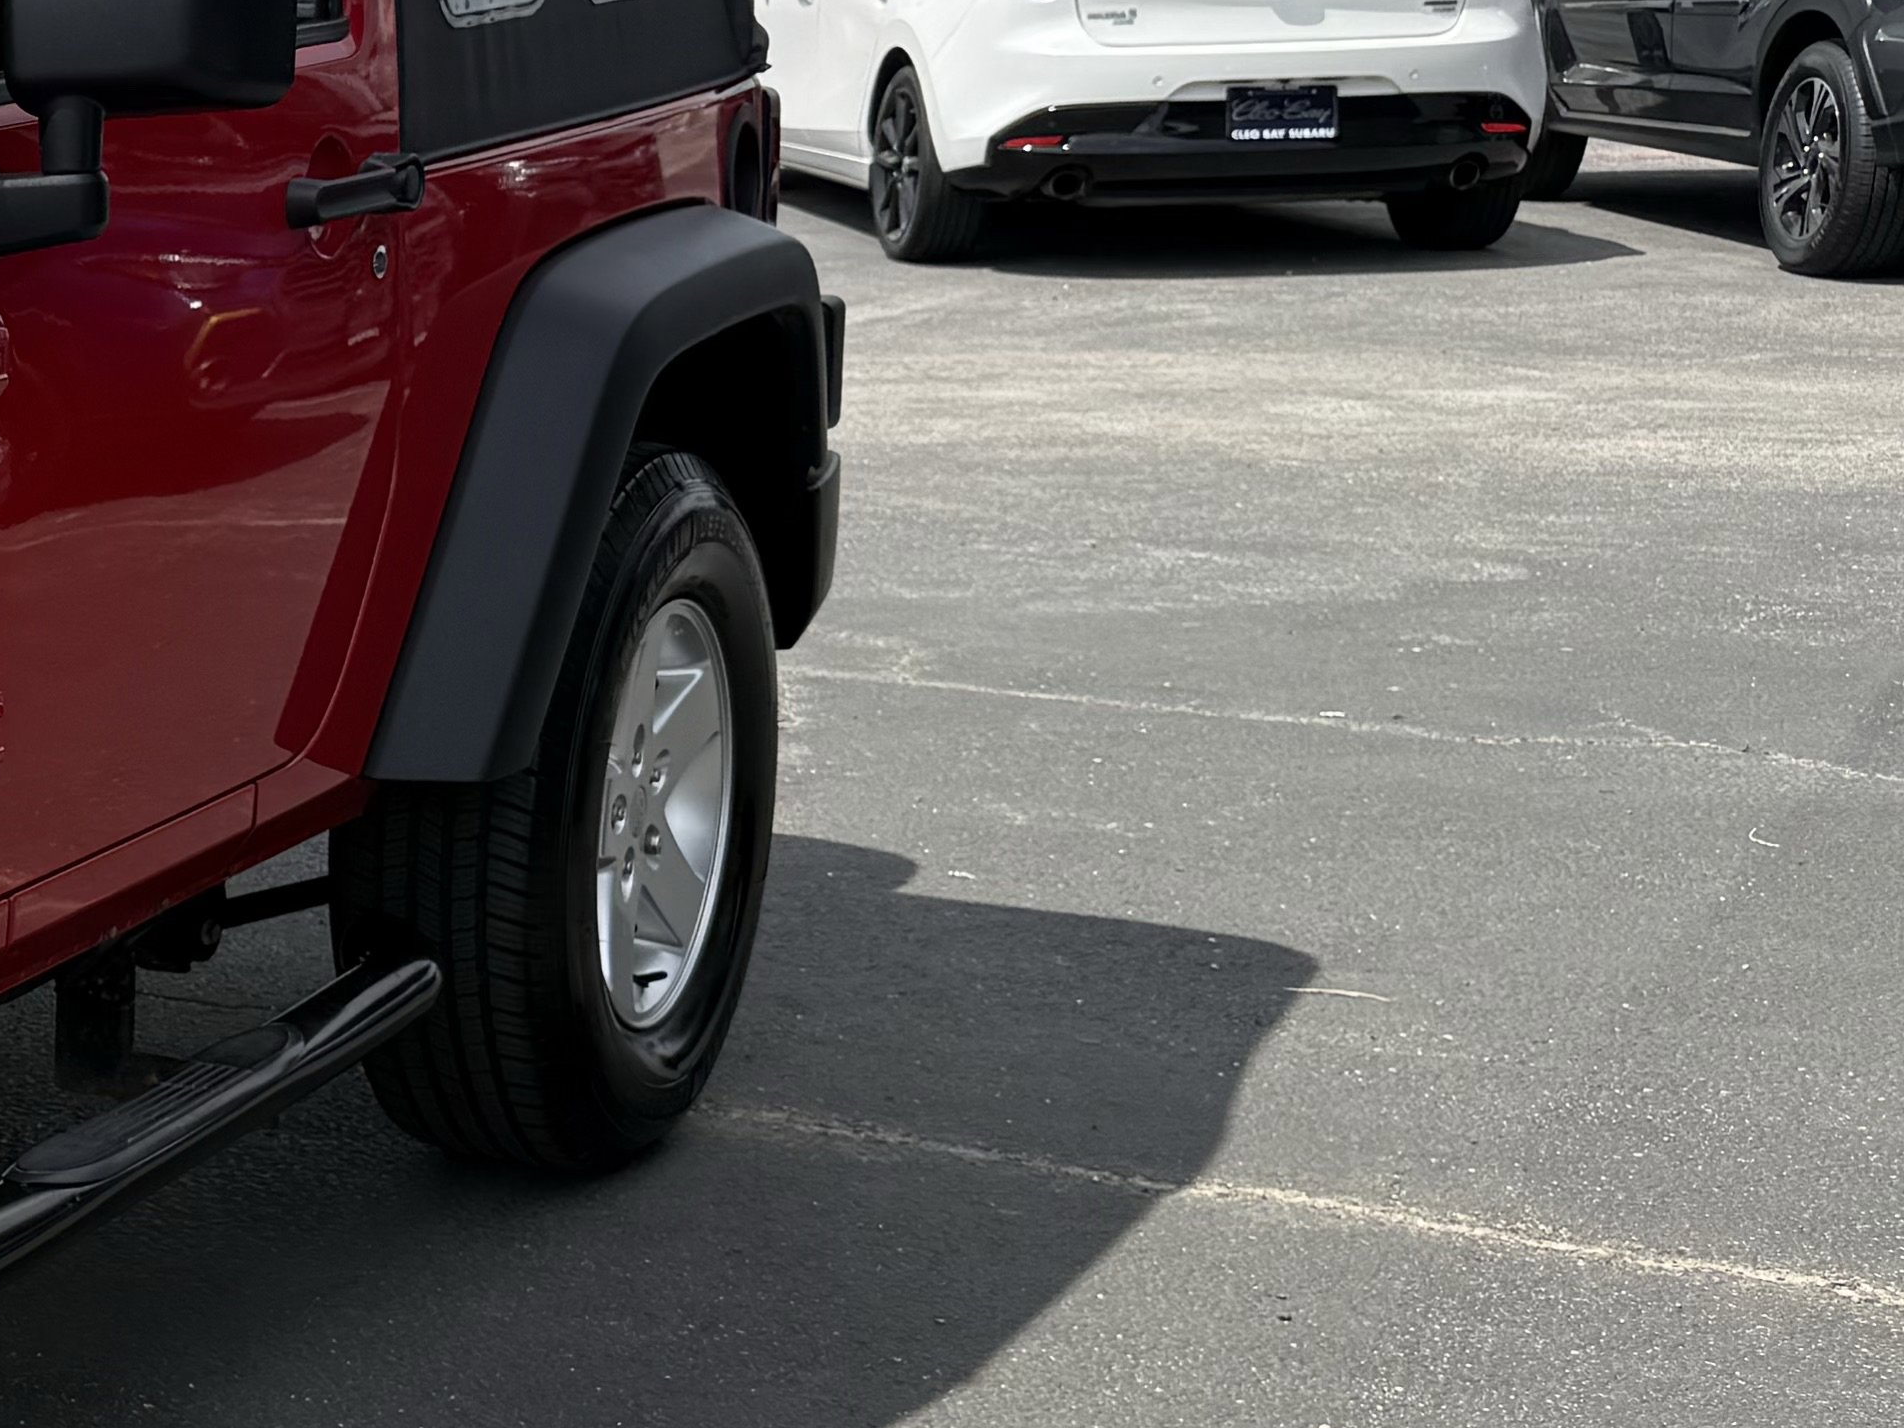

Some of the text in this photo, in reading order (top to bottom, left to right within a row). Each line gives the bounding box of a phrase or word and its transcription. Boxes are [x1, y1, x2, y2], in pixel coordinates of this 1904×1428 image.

[1231, 127, 1336, 140] CLEO BAY SUBARU
